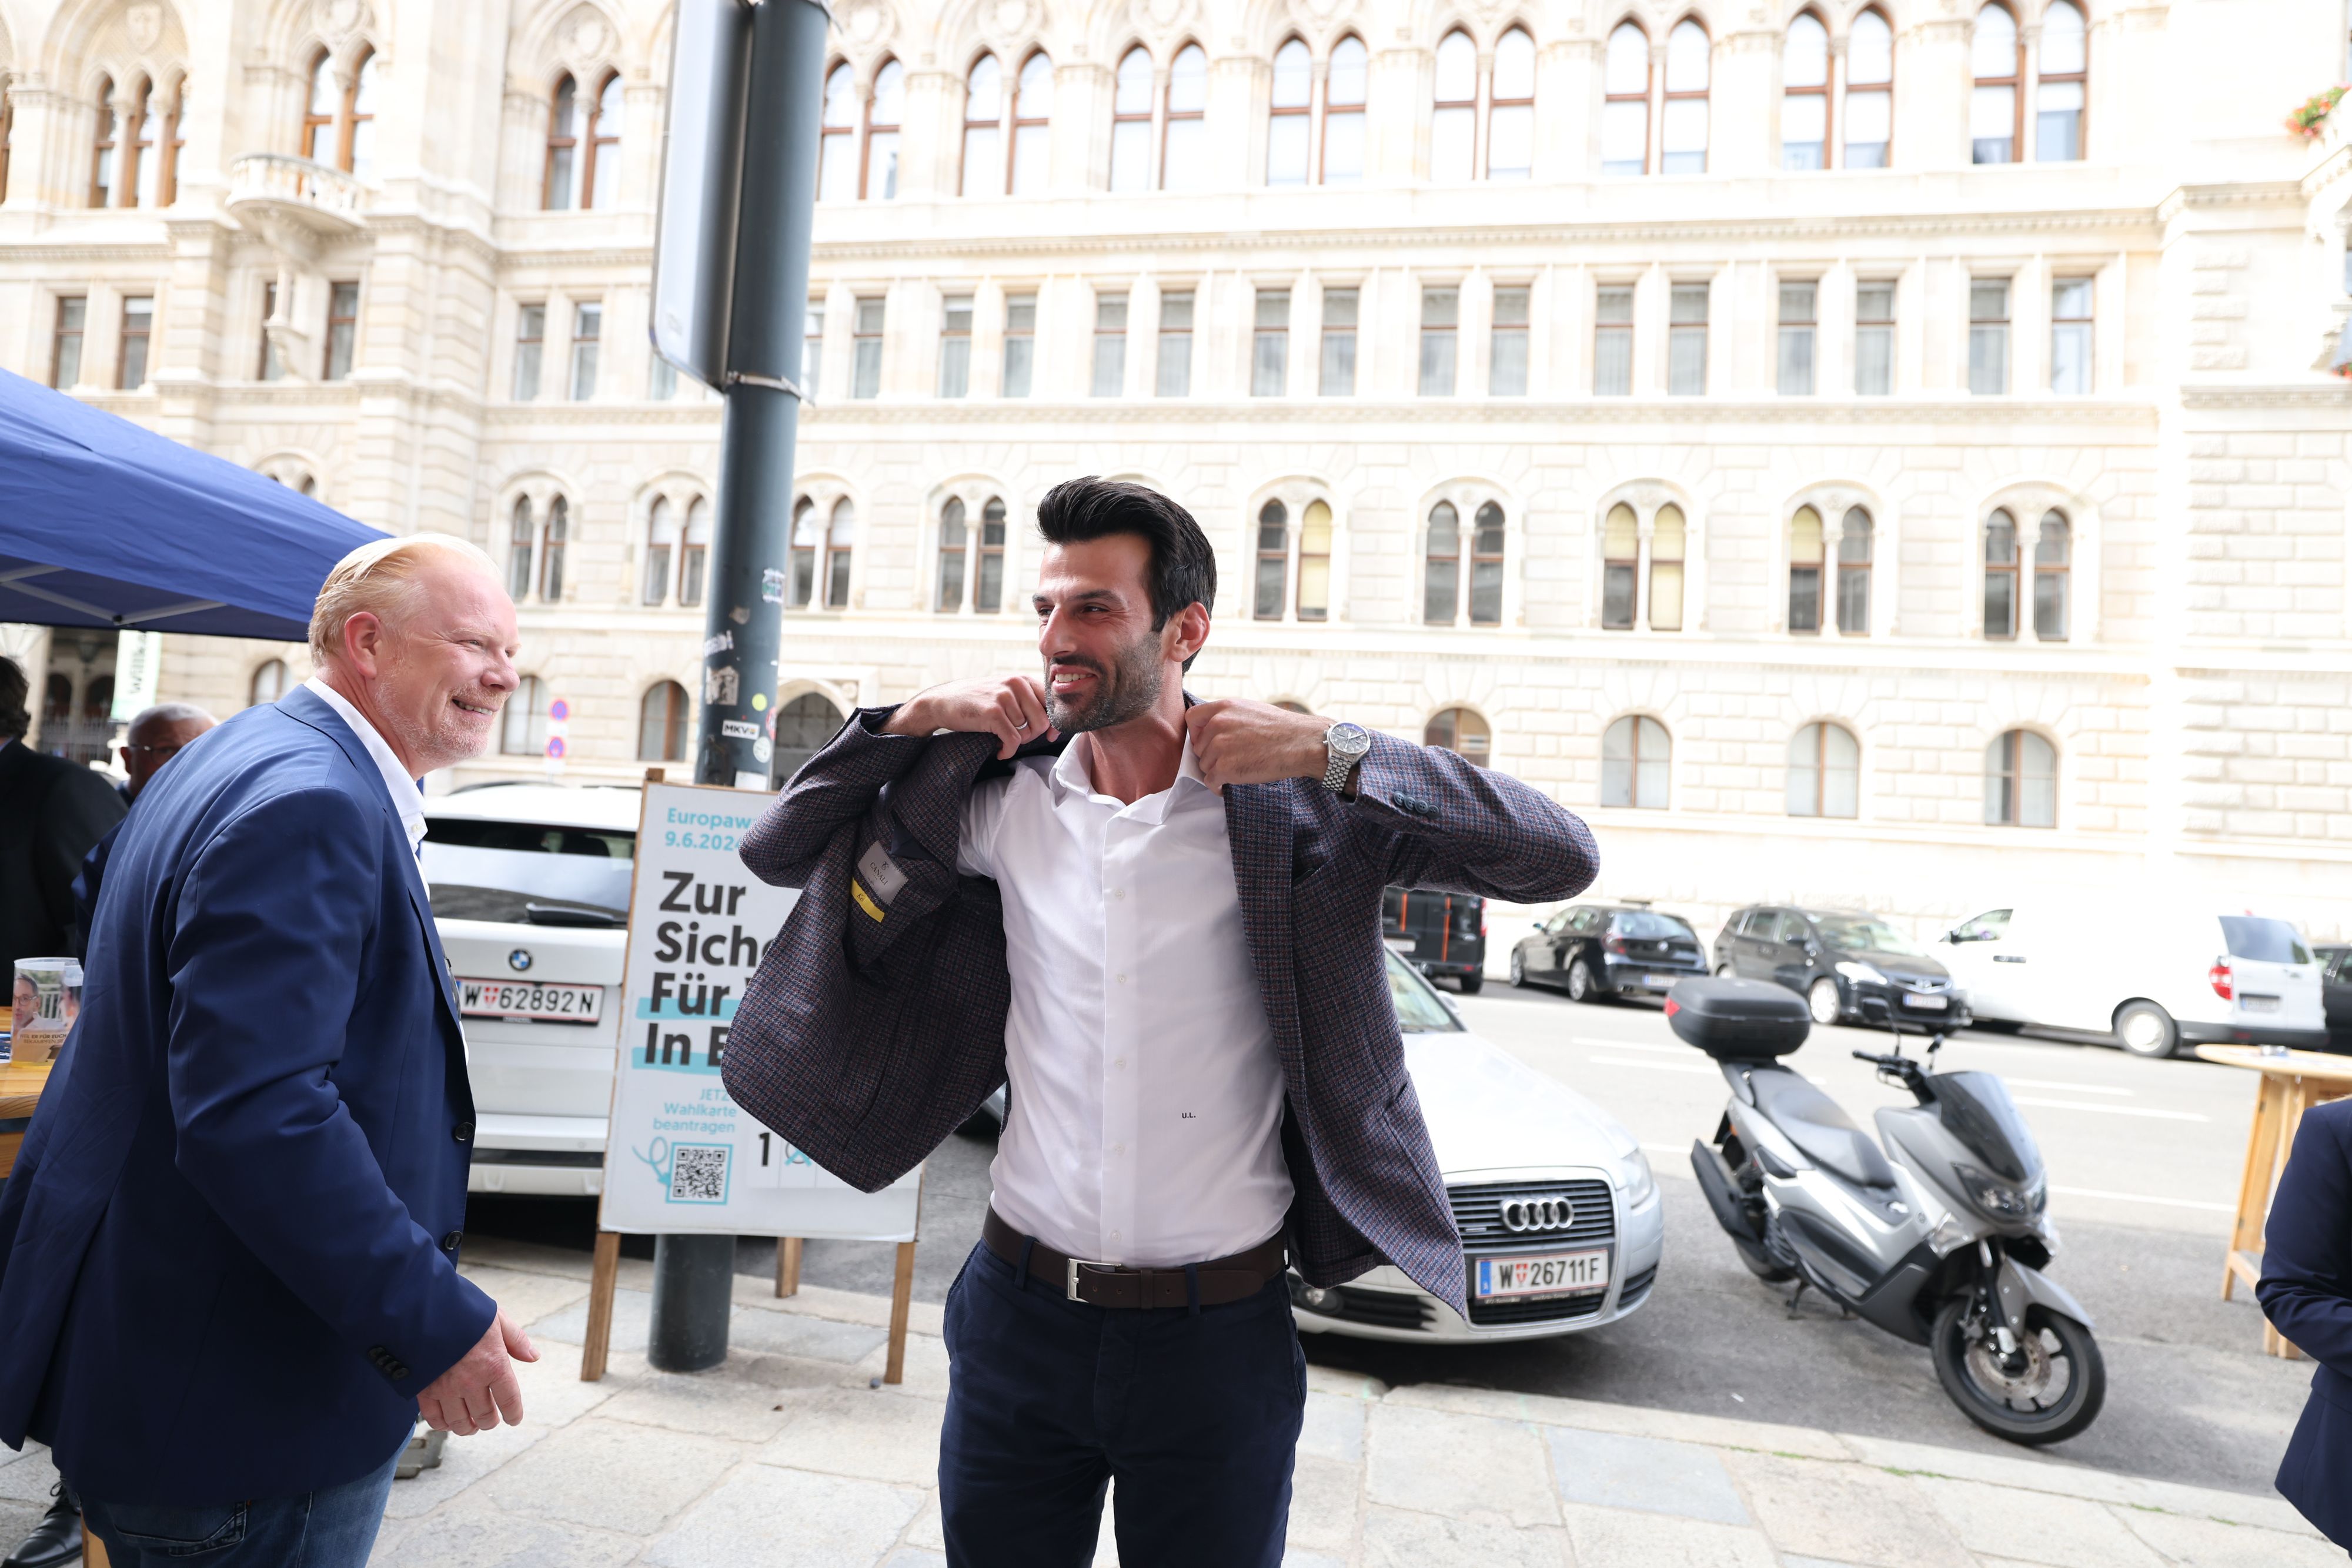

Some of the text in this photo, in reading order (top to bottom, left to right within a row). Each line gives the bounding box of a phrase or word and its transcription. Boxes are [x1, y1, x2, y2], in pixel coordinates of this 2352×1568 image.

[667, 807, 756, 830] Europaw
[870, 862, 888, 885] CANALI
[659, 871, 746, 916] Zur
[465, 985, 481, 1007] W
[650, 972, 730, 1017] Für
[644, 1022, 691, 1066] In
[700, 1089, 729, 1101] JETZ
[664, 1102, 737, 1117] Wahlkarte
[653, 1118, 734, 1134] beantragen
[759, 1132, 770, 1167] 1
[1499, 1264, 1513, 1289] W
